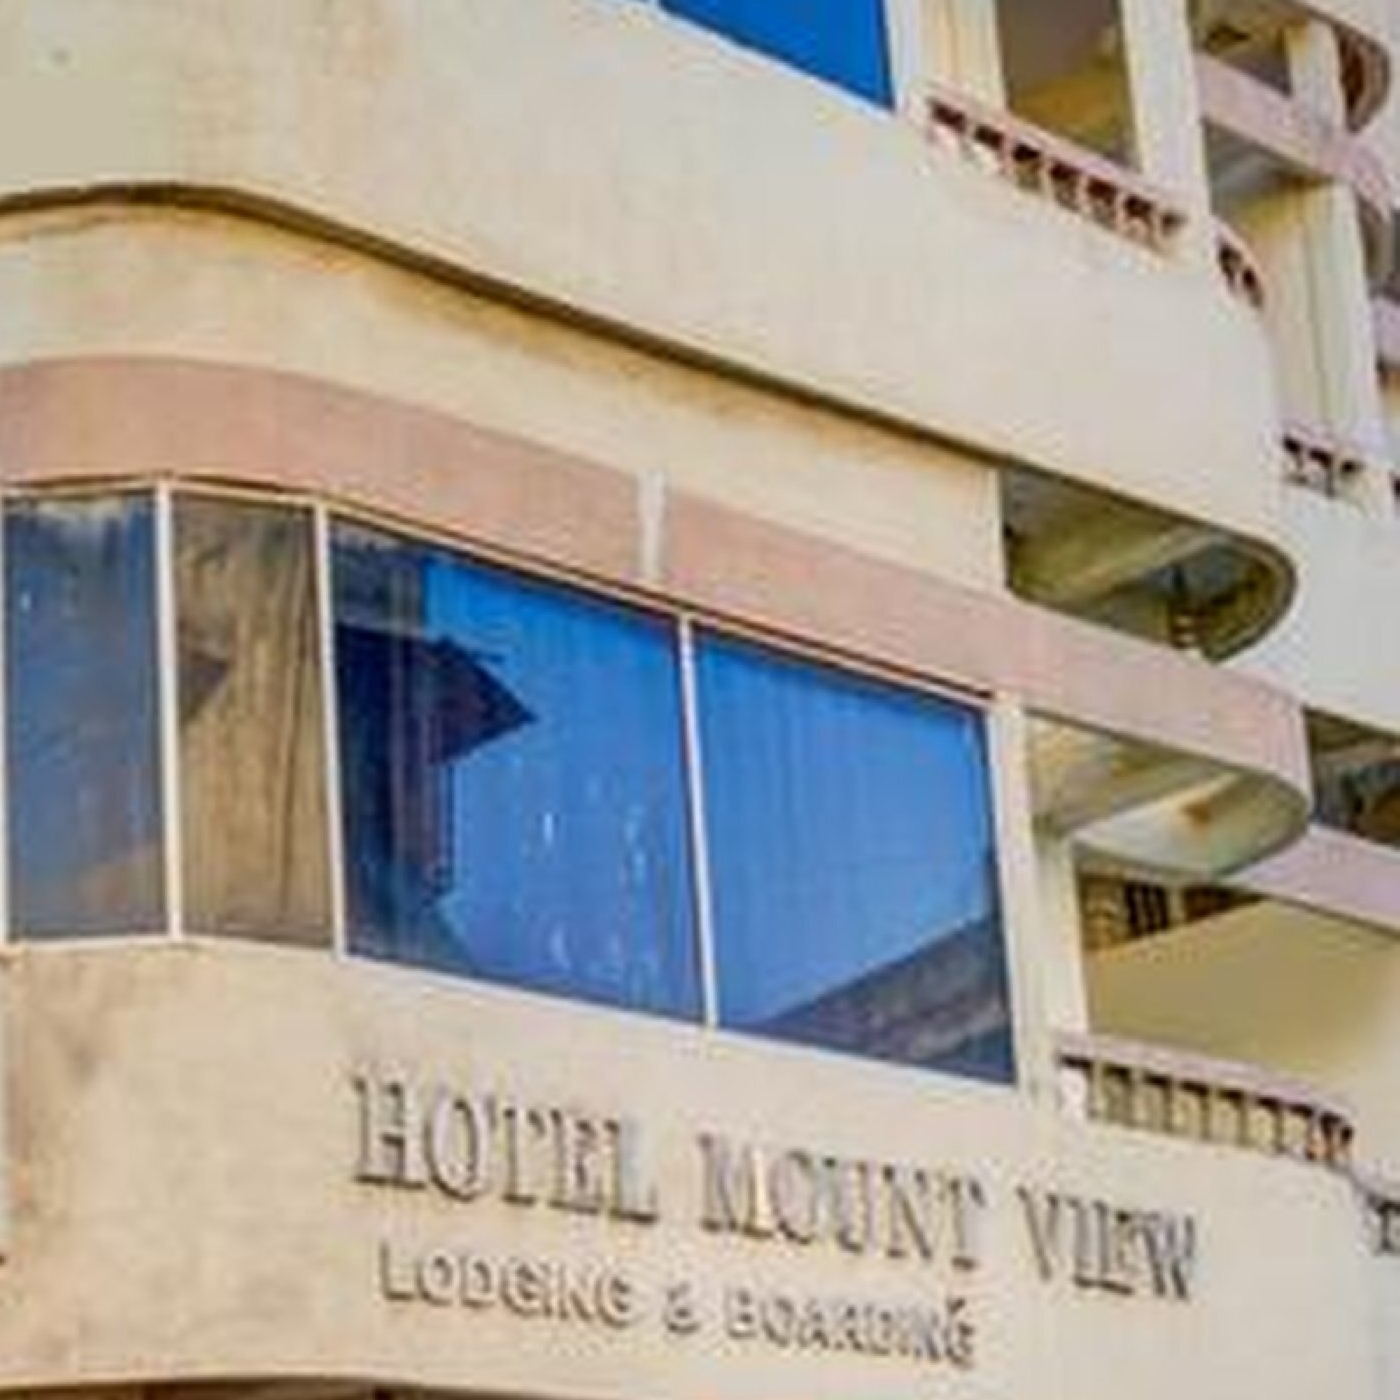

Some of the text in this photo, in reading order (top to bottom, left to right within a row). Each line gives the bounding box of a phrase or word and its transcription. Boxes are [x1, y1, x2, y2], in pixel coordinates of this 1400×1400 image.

[353, 1072, 1197, 1300] HOTEL MOUNT VIEW
[379, 1242, 636, 1329] LODGING
[724, 1289, 978, 1368] BOARDING
